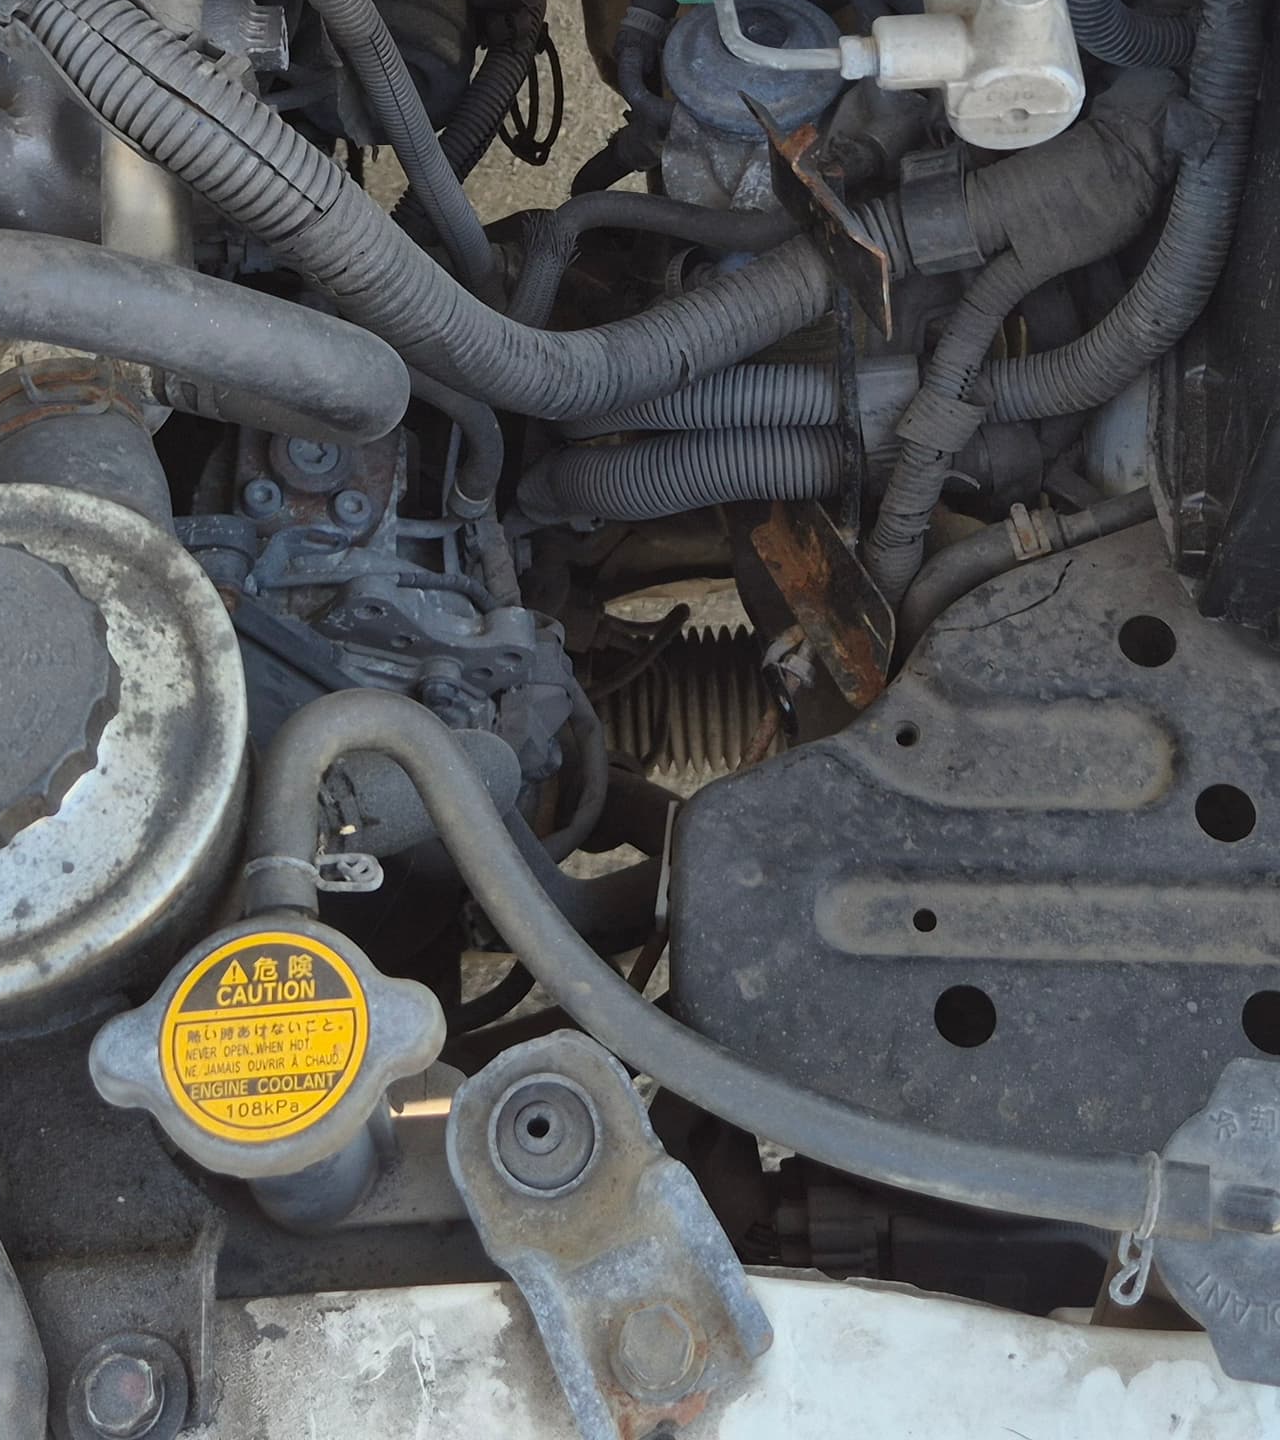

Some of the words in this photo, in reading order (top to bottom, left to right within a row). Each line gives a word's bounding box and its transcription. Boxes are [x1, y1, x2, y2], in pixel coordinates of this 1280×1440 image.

[253, 955, 313, 983] 危険
[216, 979, 316, 1007] CAUTION
[185, 1045, 217, 1061] NEVER
[256, 1039, 283, 1054] WHEN
[203, 1061, 241, 1077] JAMAIS
[247, 1057, 285, 1072] OUVRIR
[190, 1079, 249, 1101] ENGINE
[257, 1072, 336, 1096] COOLANT
[226, 1098, 300, 1119] 108kPa
